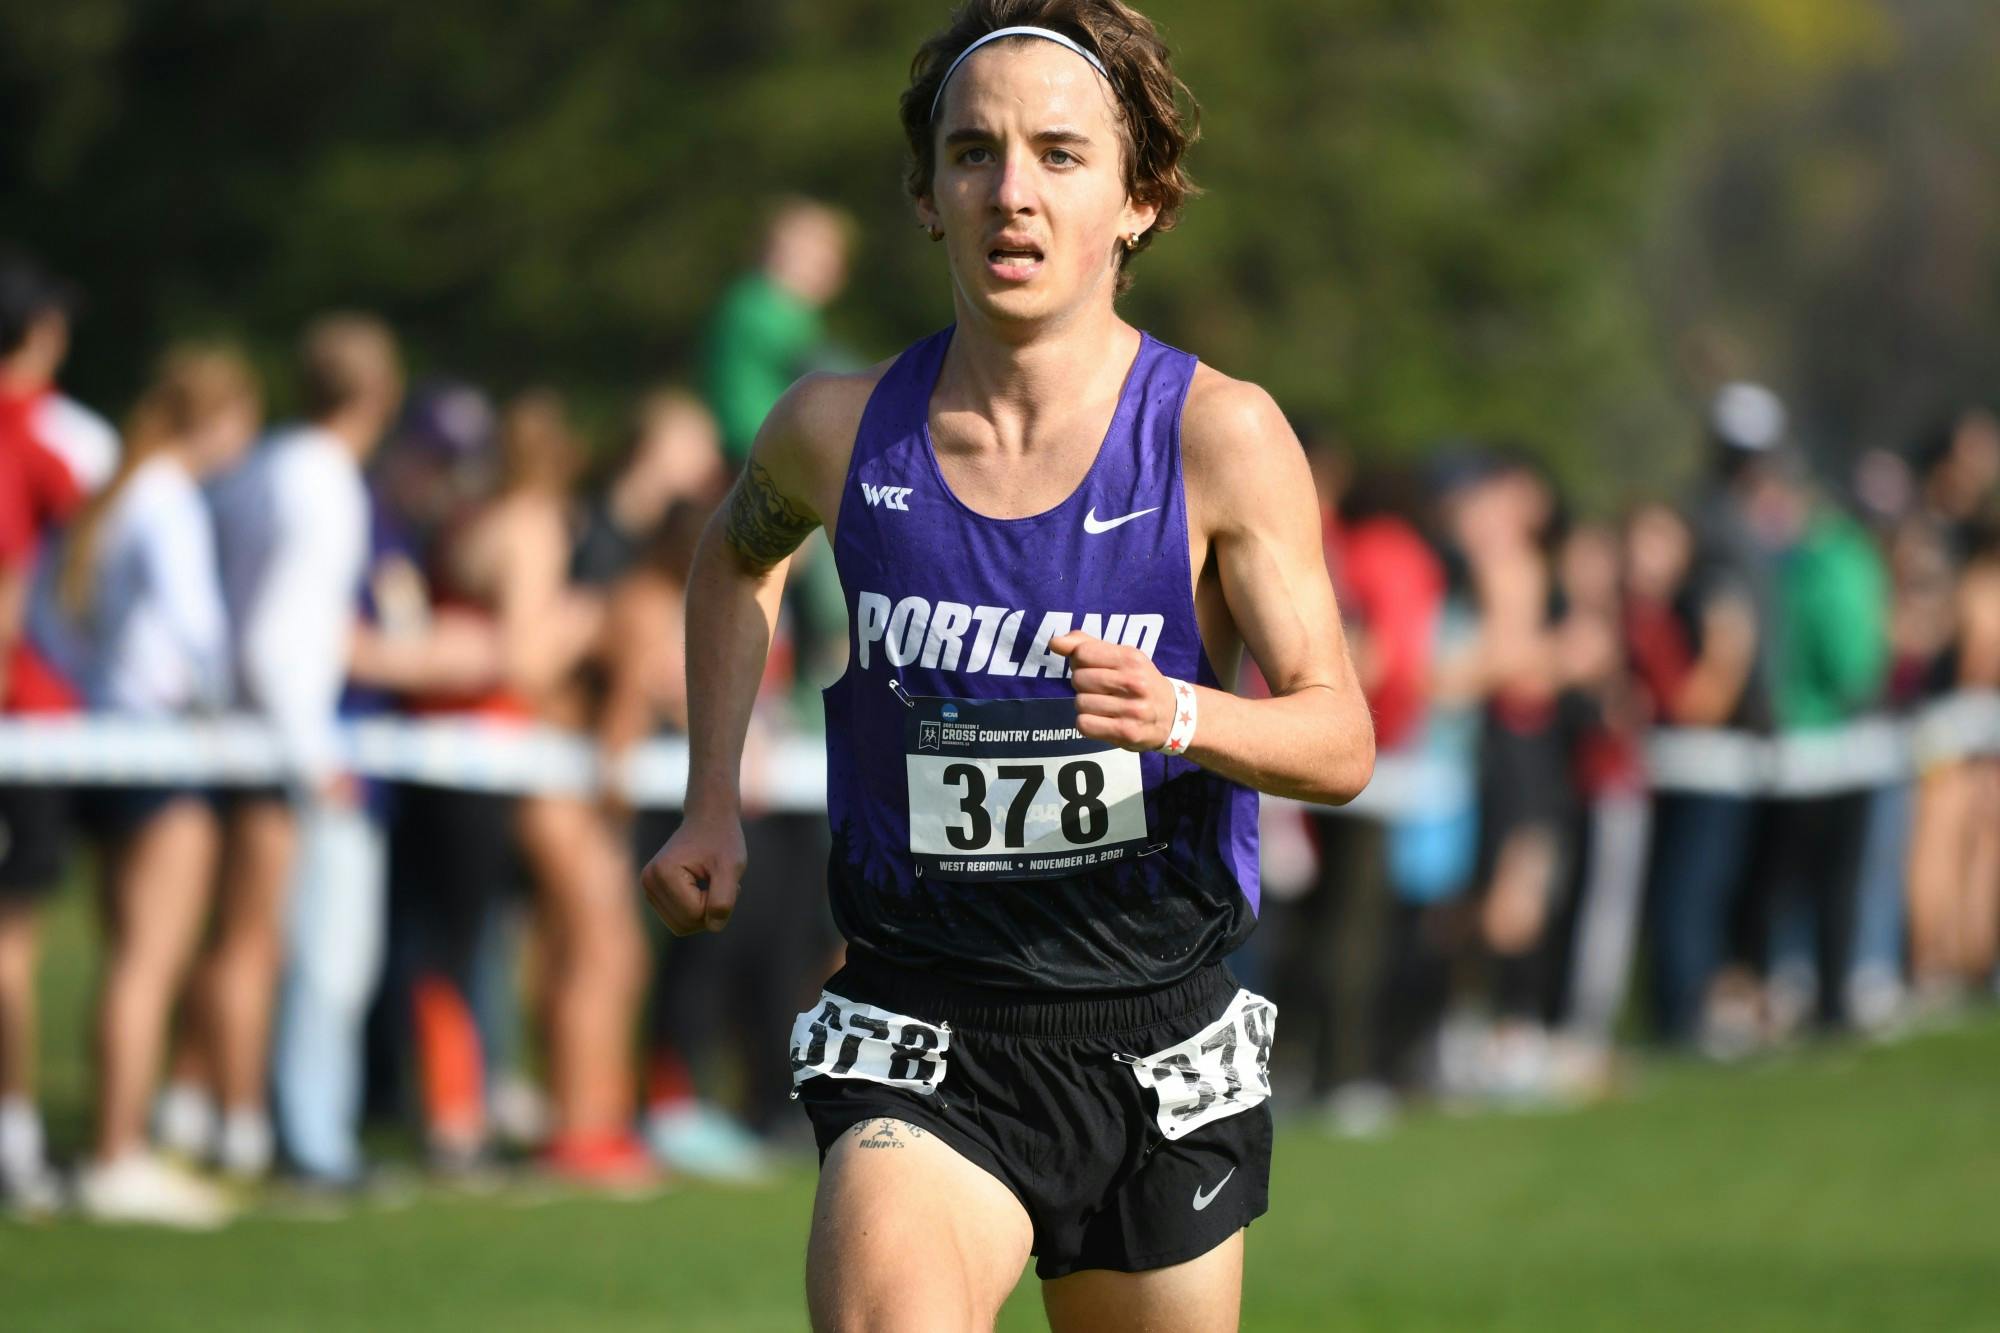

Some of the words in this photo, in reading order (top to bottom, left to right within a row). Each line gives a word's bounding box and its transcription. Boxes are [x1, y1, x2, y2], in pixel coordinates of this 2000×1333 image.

[861, 483, 914, 511] WCC
[942, 728, 977, 742] CROSS
[979, 730, 1029, 742] COUNTRY
[943, 760, 1109, 850] 378
[939, 861, 965, 872] WEST
[966, 860, 1013, 872] REGIONAL
[1029, 855, 1083, 870] NOVEMBER
[1085, 853, 1098, 864] 12,
[1100, 848, 1124, 861] 2021
